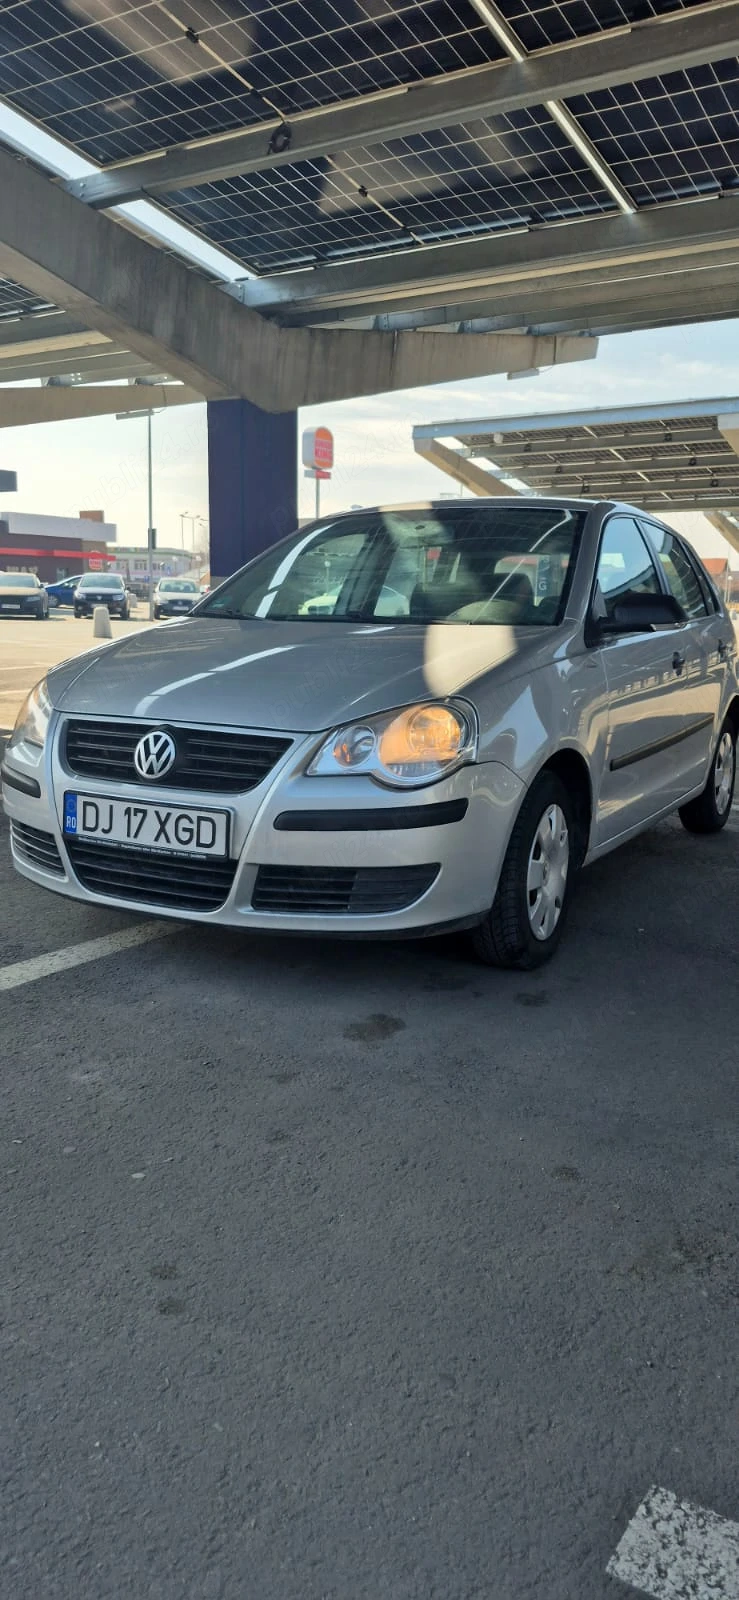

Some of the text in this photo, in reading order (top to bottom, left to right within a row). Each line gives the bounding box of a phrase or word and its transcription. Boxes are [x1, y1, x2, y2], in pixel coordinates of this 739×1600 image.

[66, 815, 77, 828] RO
[82, 800, 114, 834] DJ
[124, 806, 148, 839] 17
[153, 810, 217, 849] XGD
